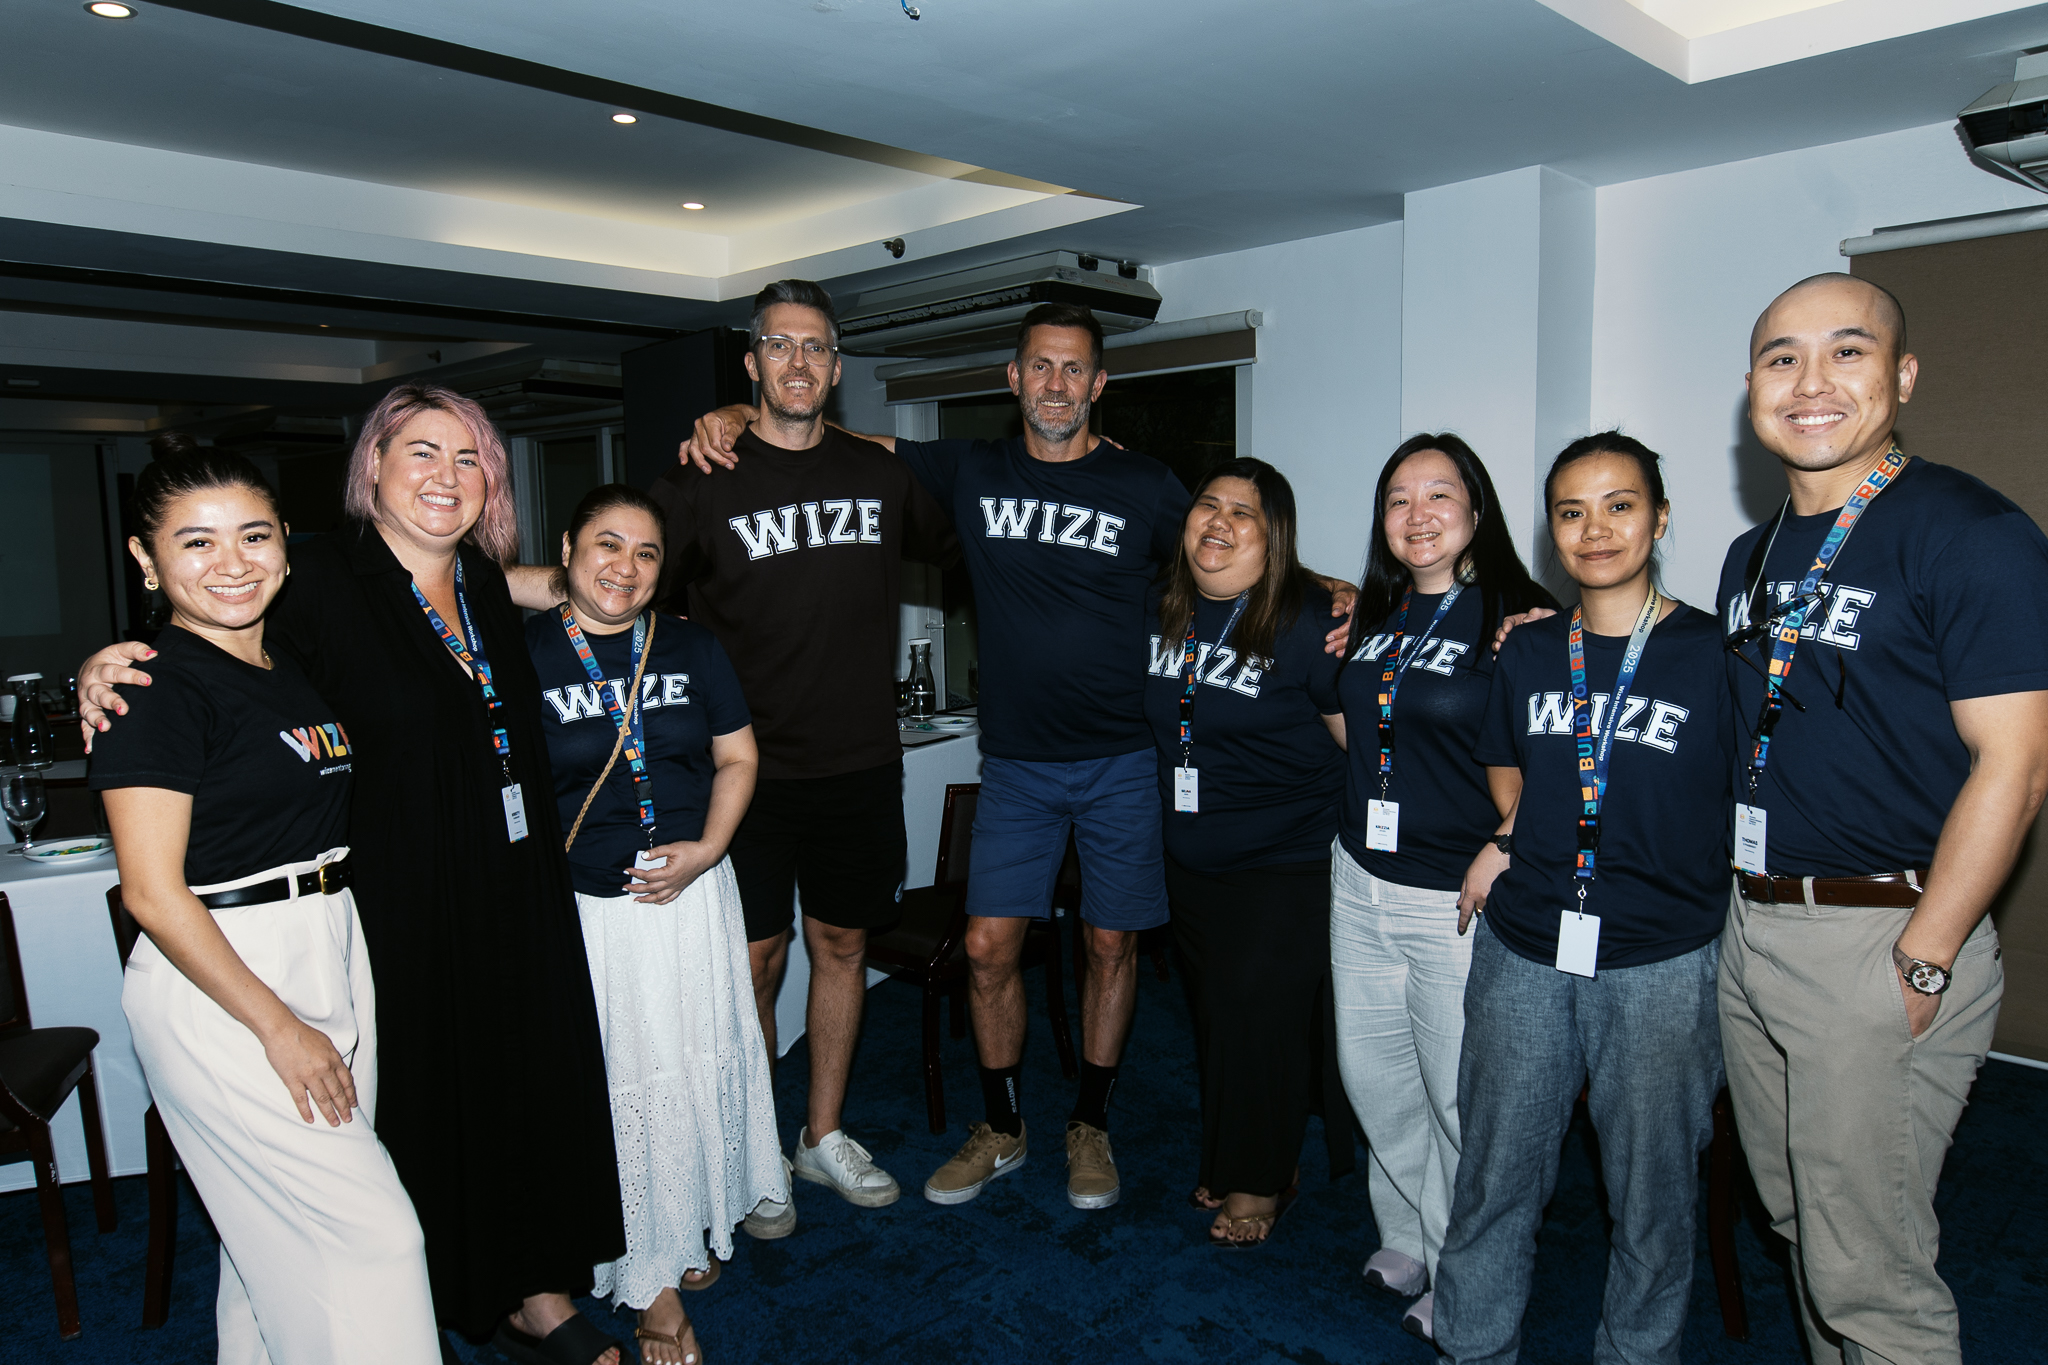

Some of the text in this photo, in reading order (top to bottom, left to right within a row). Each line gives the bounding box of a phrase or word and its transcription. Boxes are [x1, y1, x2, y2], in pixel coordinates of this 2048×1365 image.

[729, 499, 882, 561] WIZE
[980, 497, 1126, 556] WIZE
[1810, 512, 1857, 572] YOUR
[1440, 589, 1459, 611] 2025
[431, 617, 473, 661] BUILD
[467, 625, 478, 652] Workshop
[633, 630, 644, 654] 2025
[1382, 641, 1401, 681] BUILD
[1394, 601, 1410, 639] YOUR
[1622, 644, 1641, 674] 2025
[577, 646, 607, 691] YOUR
[1148, 634, 1275, 698] WIZE
[1569, 604, 1595, 771] BUILD YOUR FREE
[543, 673, 690, 724] WIZE
[1527, 691, 1690, 754] WIZE
[1606, 700, 1619, 729] Intensive
[1598, 728, 1611, 762] Workshop
